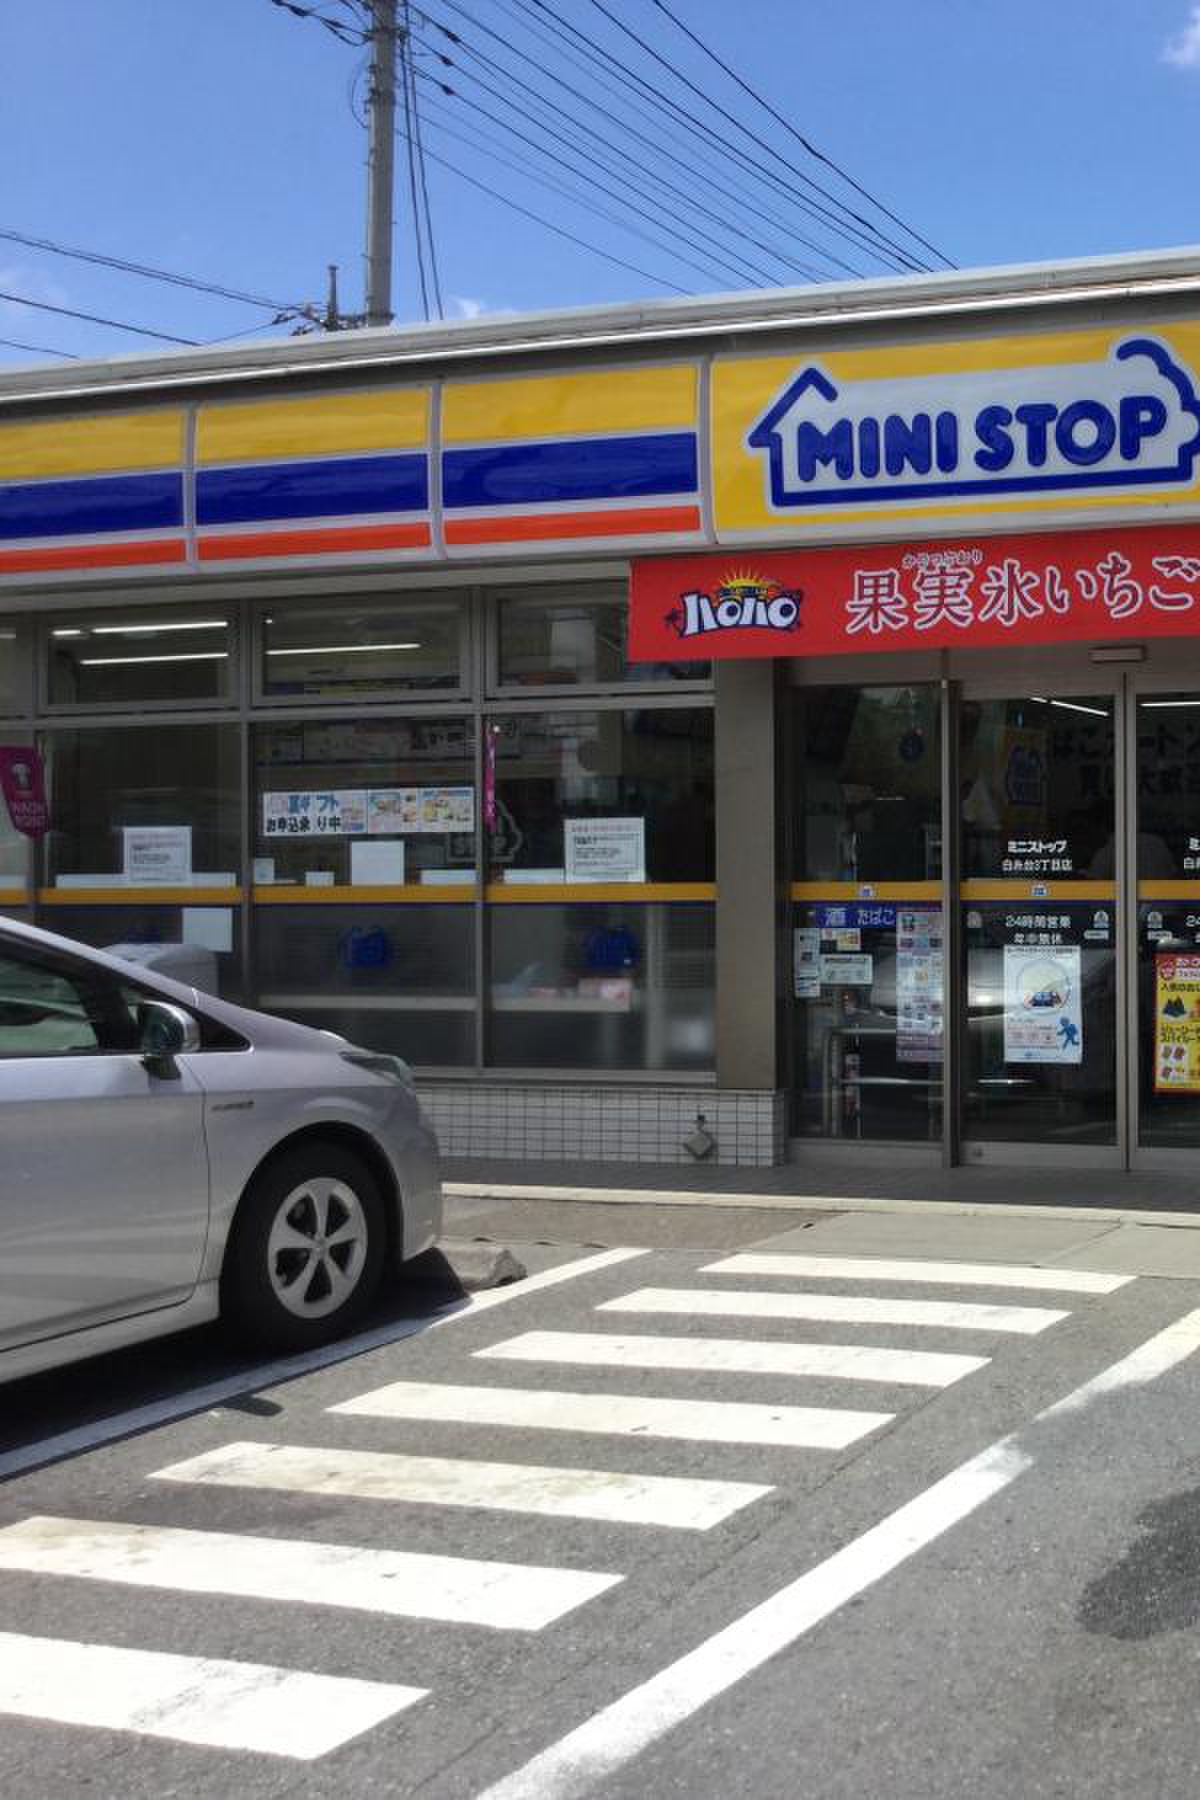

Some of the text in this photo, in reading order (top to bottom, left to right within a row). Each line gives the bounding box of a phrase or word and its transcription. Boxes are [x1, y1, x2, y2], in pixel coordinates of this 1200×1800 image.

[797, 396, 1168, 482] MINI STOP
[1007, 840, 1067, 853] ミニストップ
